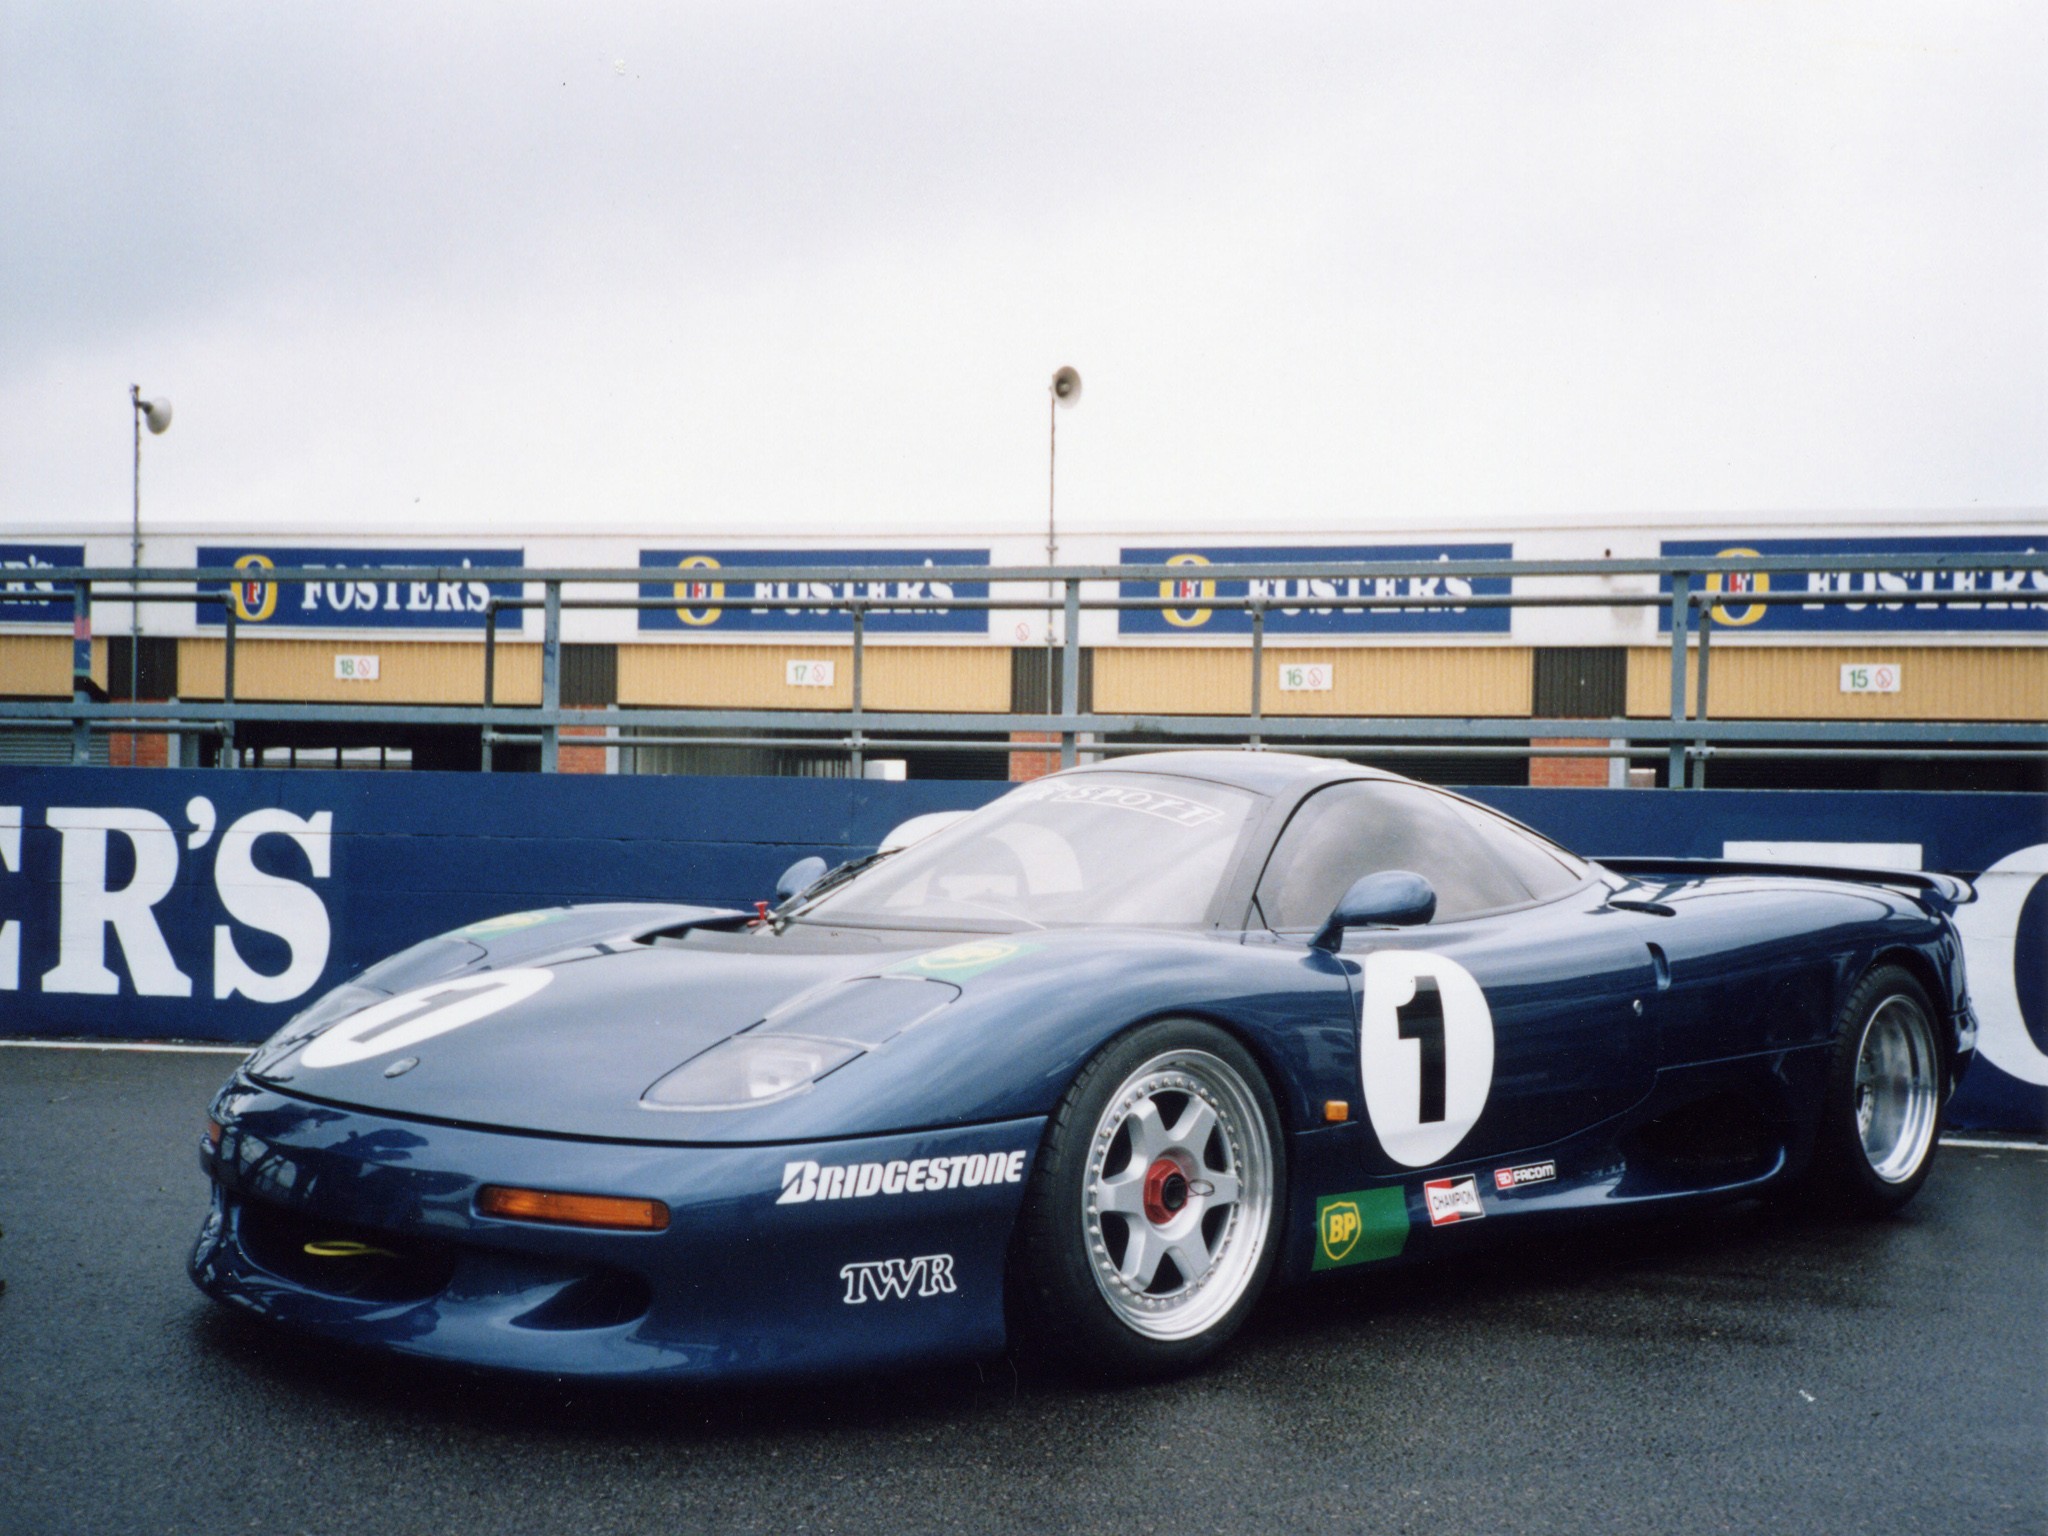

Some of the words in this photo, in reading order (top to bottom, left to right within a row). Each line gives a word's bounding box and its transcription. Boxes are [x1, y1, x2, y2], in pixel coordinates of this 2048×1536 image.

[0, 554, 54, 606] R'S
[301, 558, 491, 612] FOSTER'S
[340, 659, 354, 675] 18
[793, 664, 807, 682] 17
[1285, 668, 1303, 686] 16
[1849, 669, 1868, 688] 15
[0, 796, 332, 1003] R'S
[1396, 975, 1446, 1124] 1
[775, 1150, 1026, 1205] BRIDGESTONE
[1512, 1164, 1555, 1183] FACOM
[1433, 1190, 1475, 1210] CHAMPION
[1328, 1212, 1357, 1244] BP
[840, 1253, 957, 1304] TWR
